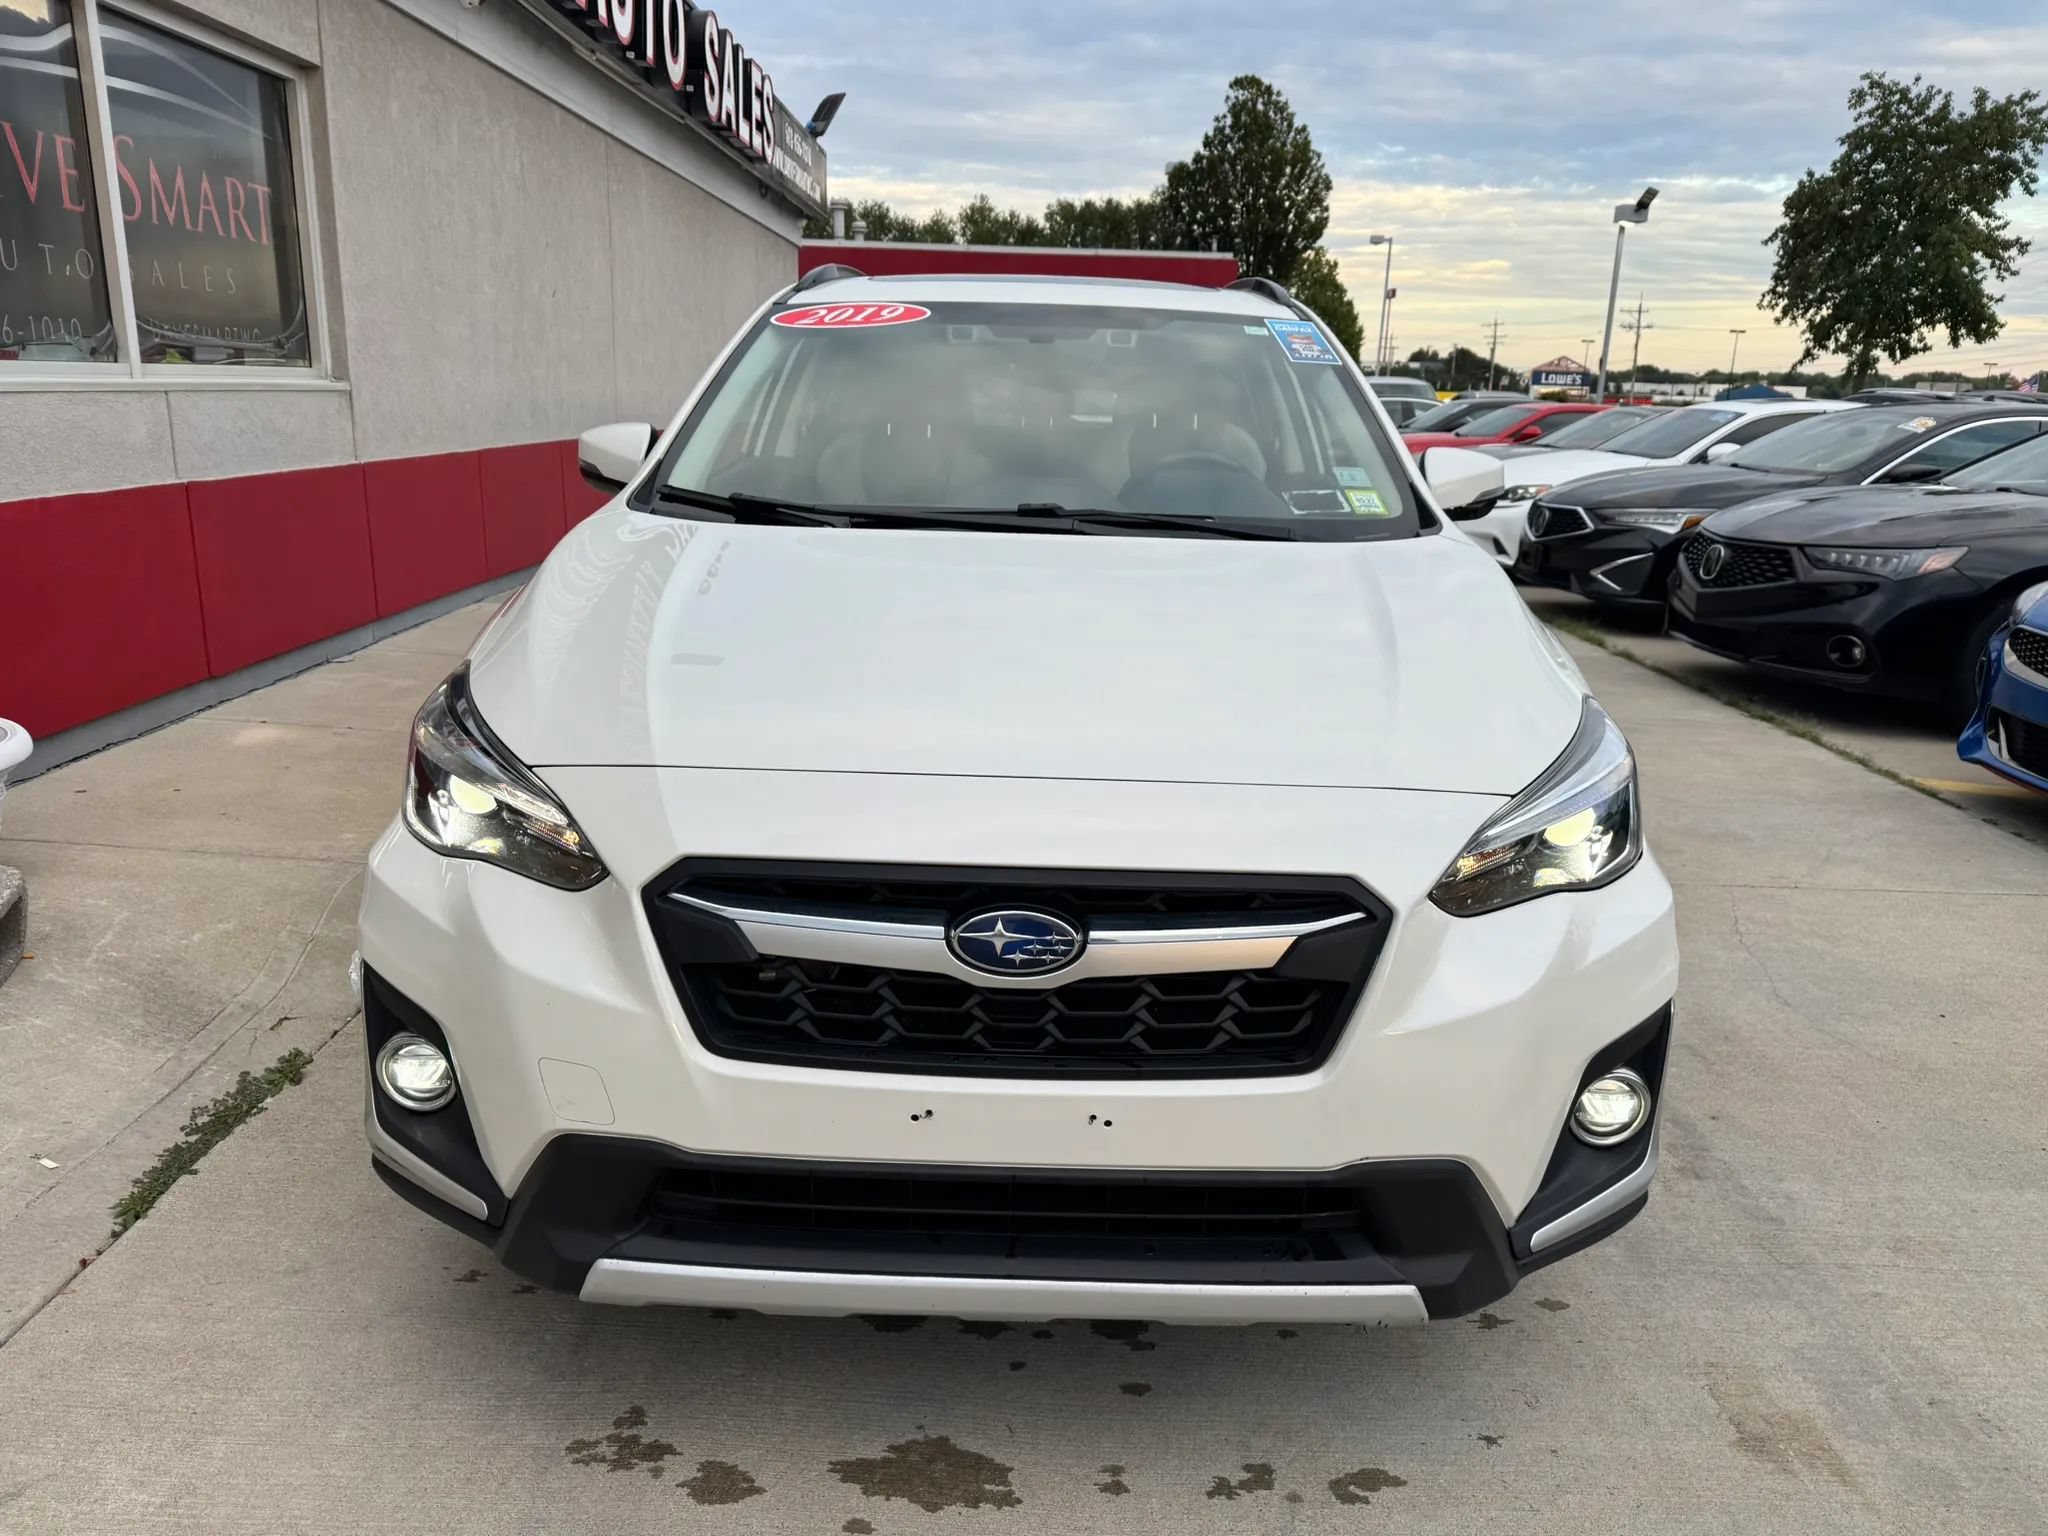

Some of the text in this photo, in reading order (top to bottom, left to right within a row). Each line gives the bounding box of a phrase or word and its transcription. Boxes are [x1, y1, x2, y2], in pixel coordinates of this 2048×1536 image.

[703, 10, 775, 165] SALES
[0, 121, 272, 245] VE SMART
[127, 254, 236, 295] ALES
[793, 305, 905, 325] 2019
[1541, 372, 1582, 384] LOWE'S
